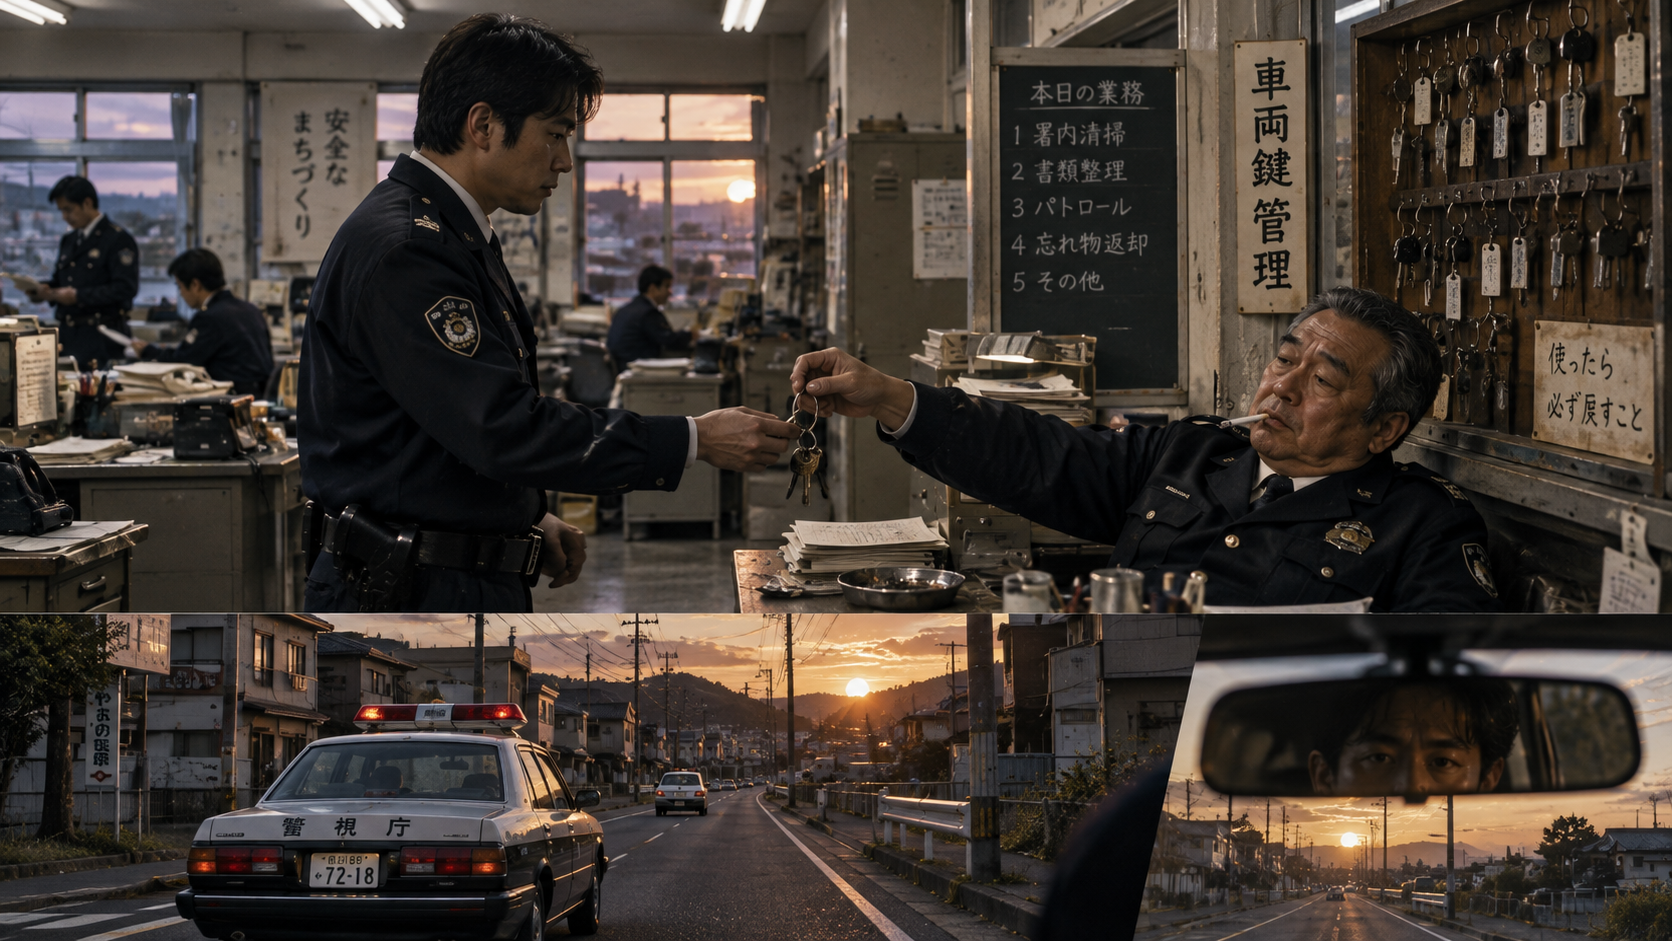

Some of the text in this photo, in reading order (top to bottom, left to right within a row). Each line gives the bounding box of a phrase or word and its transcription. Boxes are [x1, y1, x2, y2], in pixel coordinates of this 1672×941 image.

[1030, 80, 1145, 105] 本日の業務
[1014, 121, 1126, 147] 1 署内清掃
[324, 108, 349, 187] 安全な
[292, 110, 316, 239] まちづくり
[1012, 159, 1128, 183] 2 書類整理
[1251, 57, 1293, 290] 車両鍵管理
[1012, 197, 1132, 217] 3 パトロール
[1011, 231, 1148, 256] 4 忘れ物返却
[1013, 271, 1104, 292] 5 その他
[1548, 342, 1613, 380] 使ったら
[326, 867, 374, 884] 72-18
